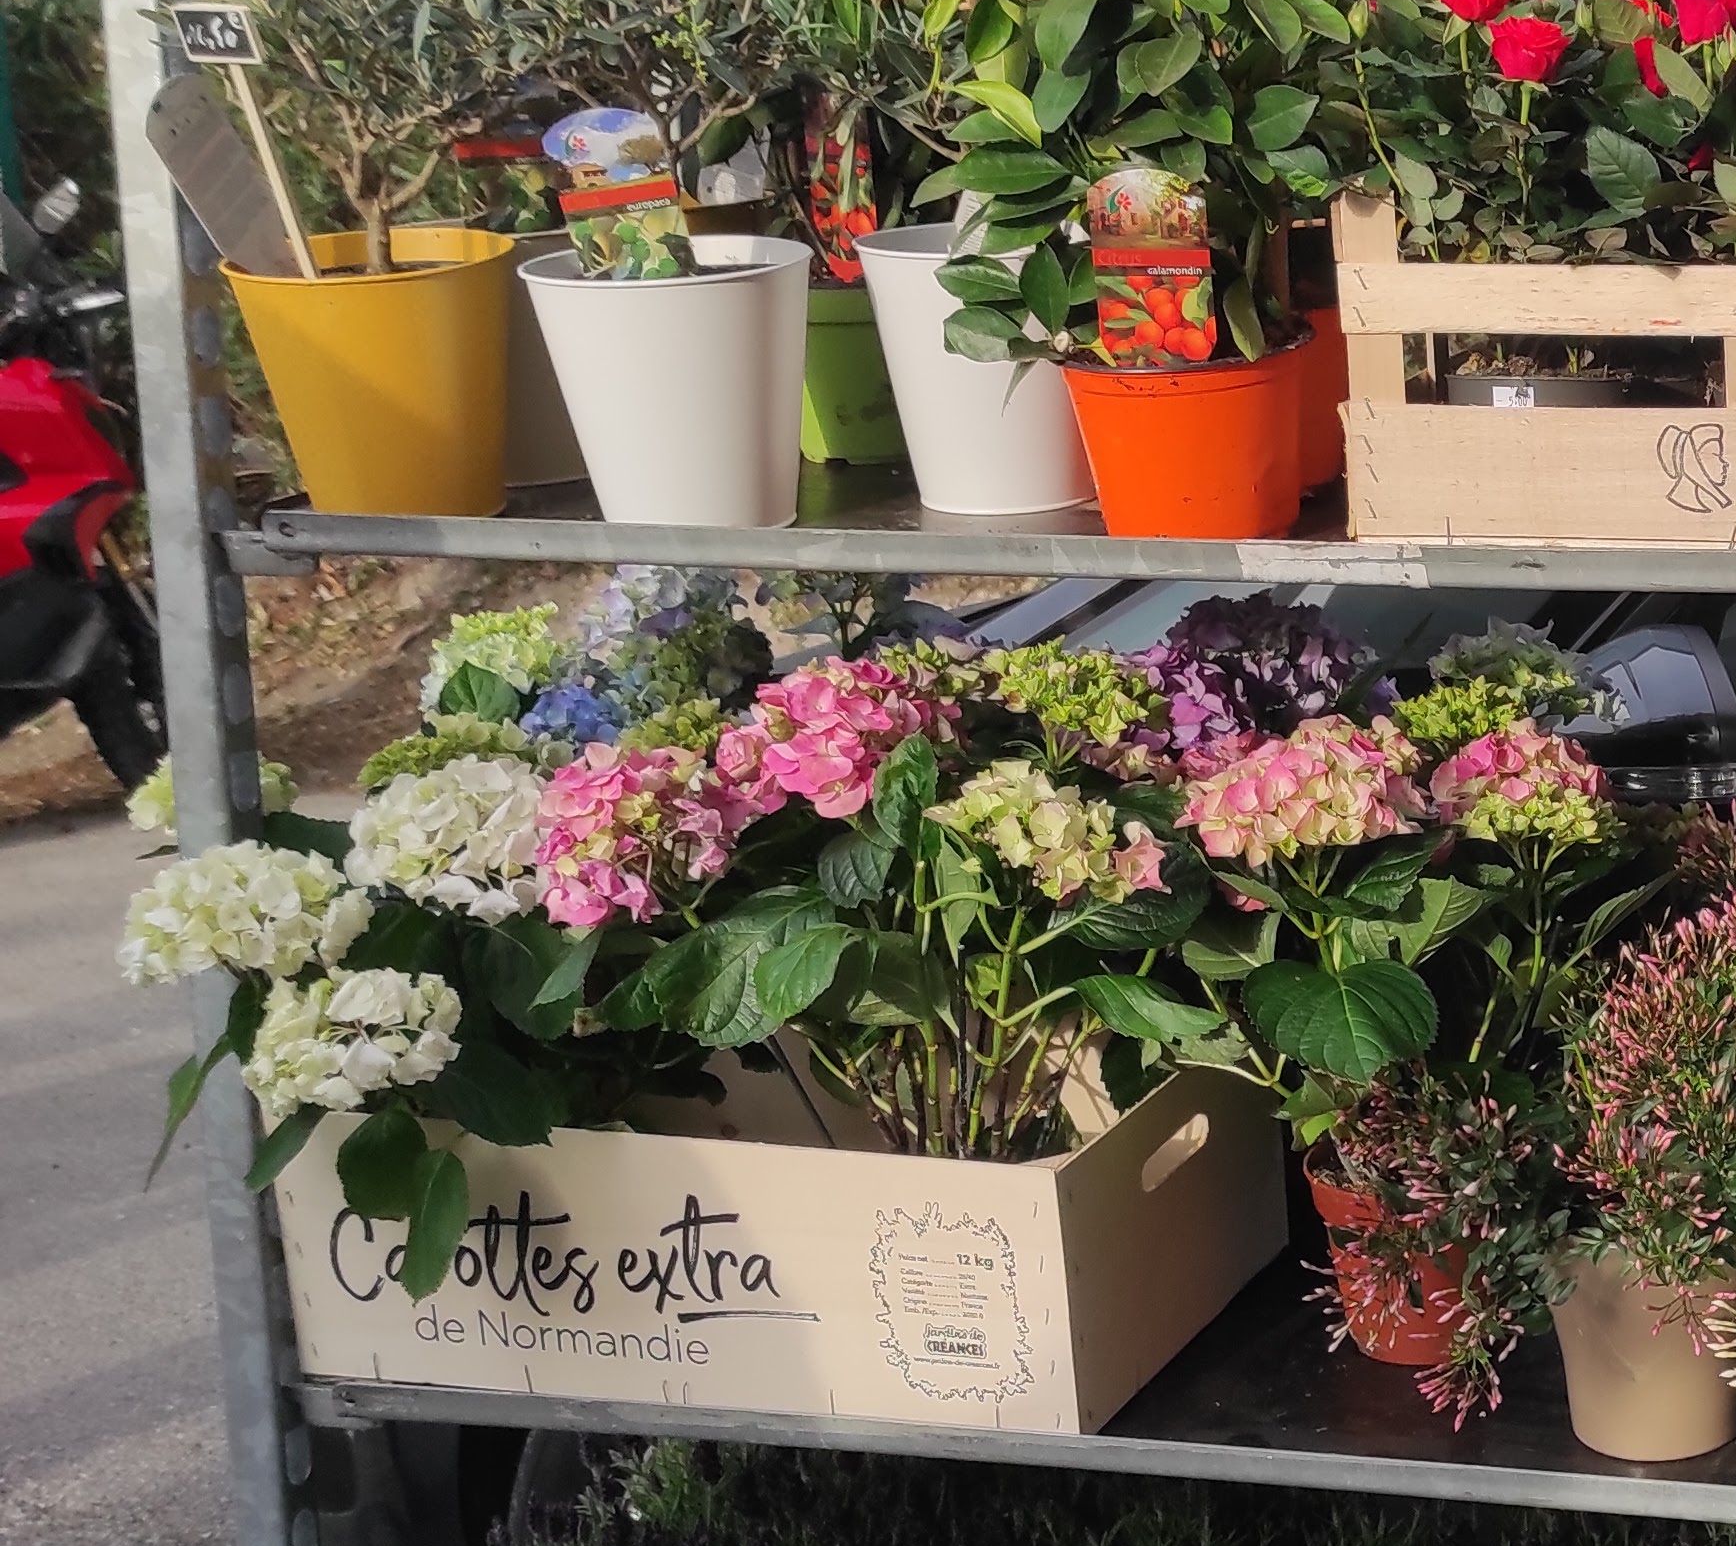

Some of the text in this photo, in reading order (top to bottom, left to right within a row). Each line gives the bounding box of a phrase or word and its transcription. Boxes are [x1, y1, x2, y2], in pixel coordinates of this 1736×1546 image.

[1147, 265, 1203, 275] calamondin
[330, 1190, 782, 1316] Caottes extra
[957, 1253, 971, 1266] 12
[974, 1253, 994, 1270] kg
[415, 1304, 710, 1366] de Normandie
